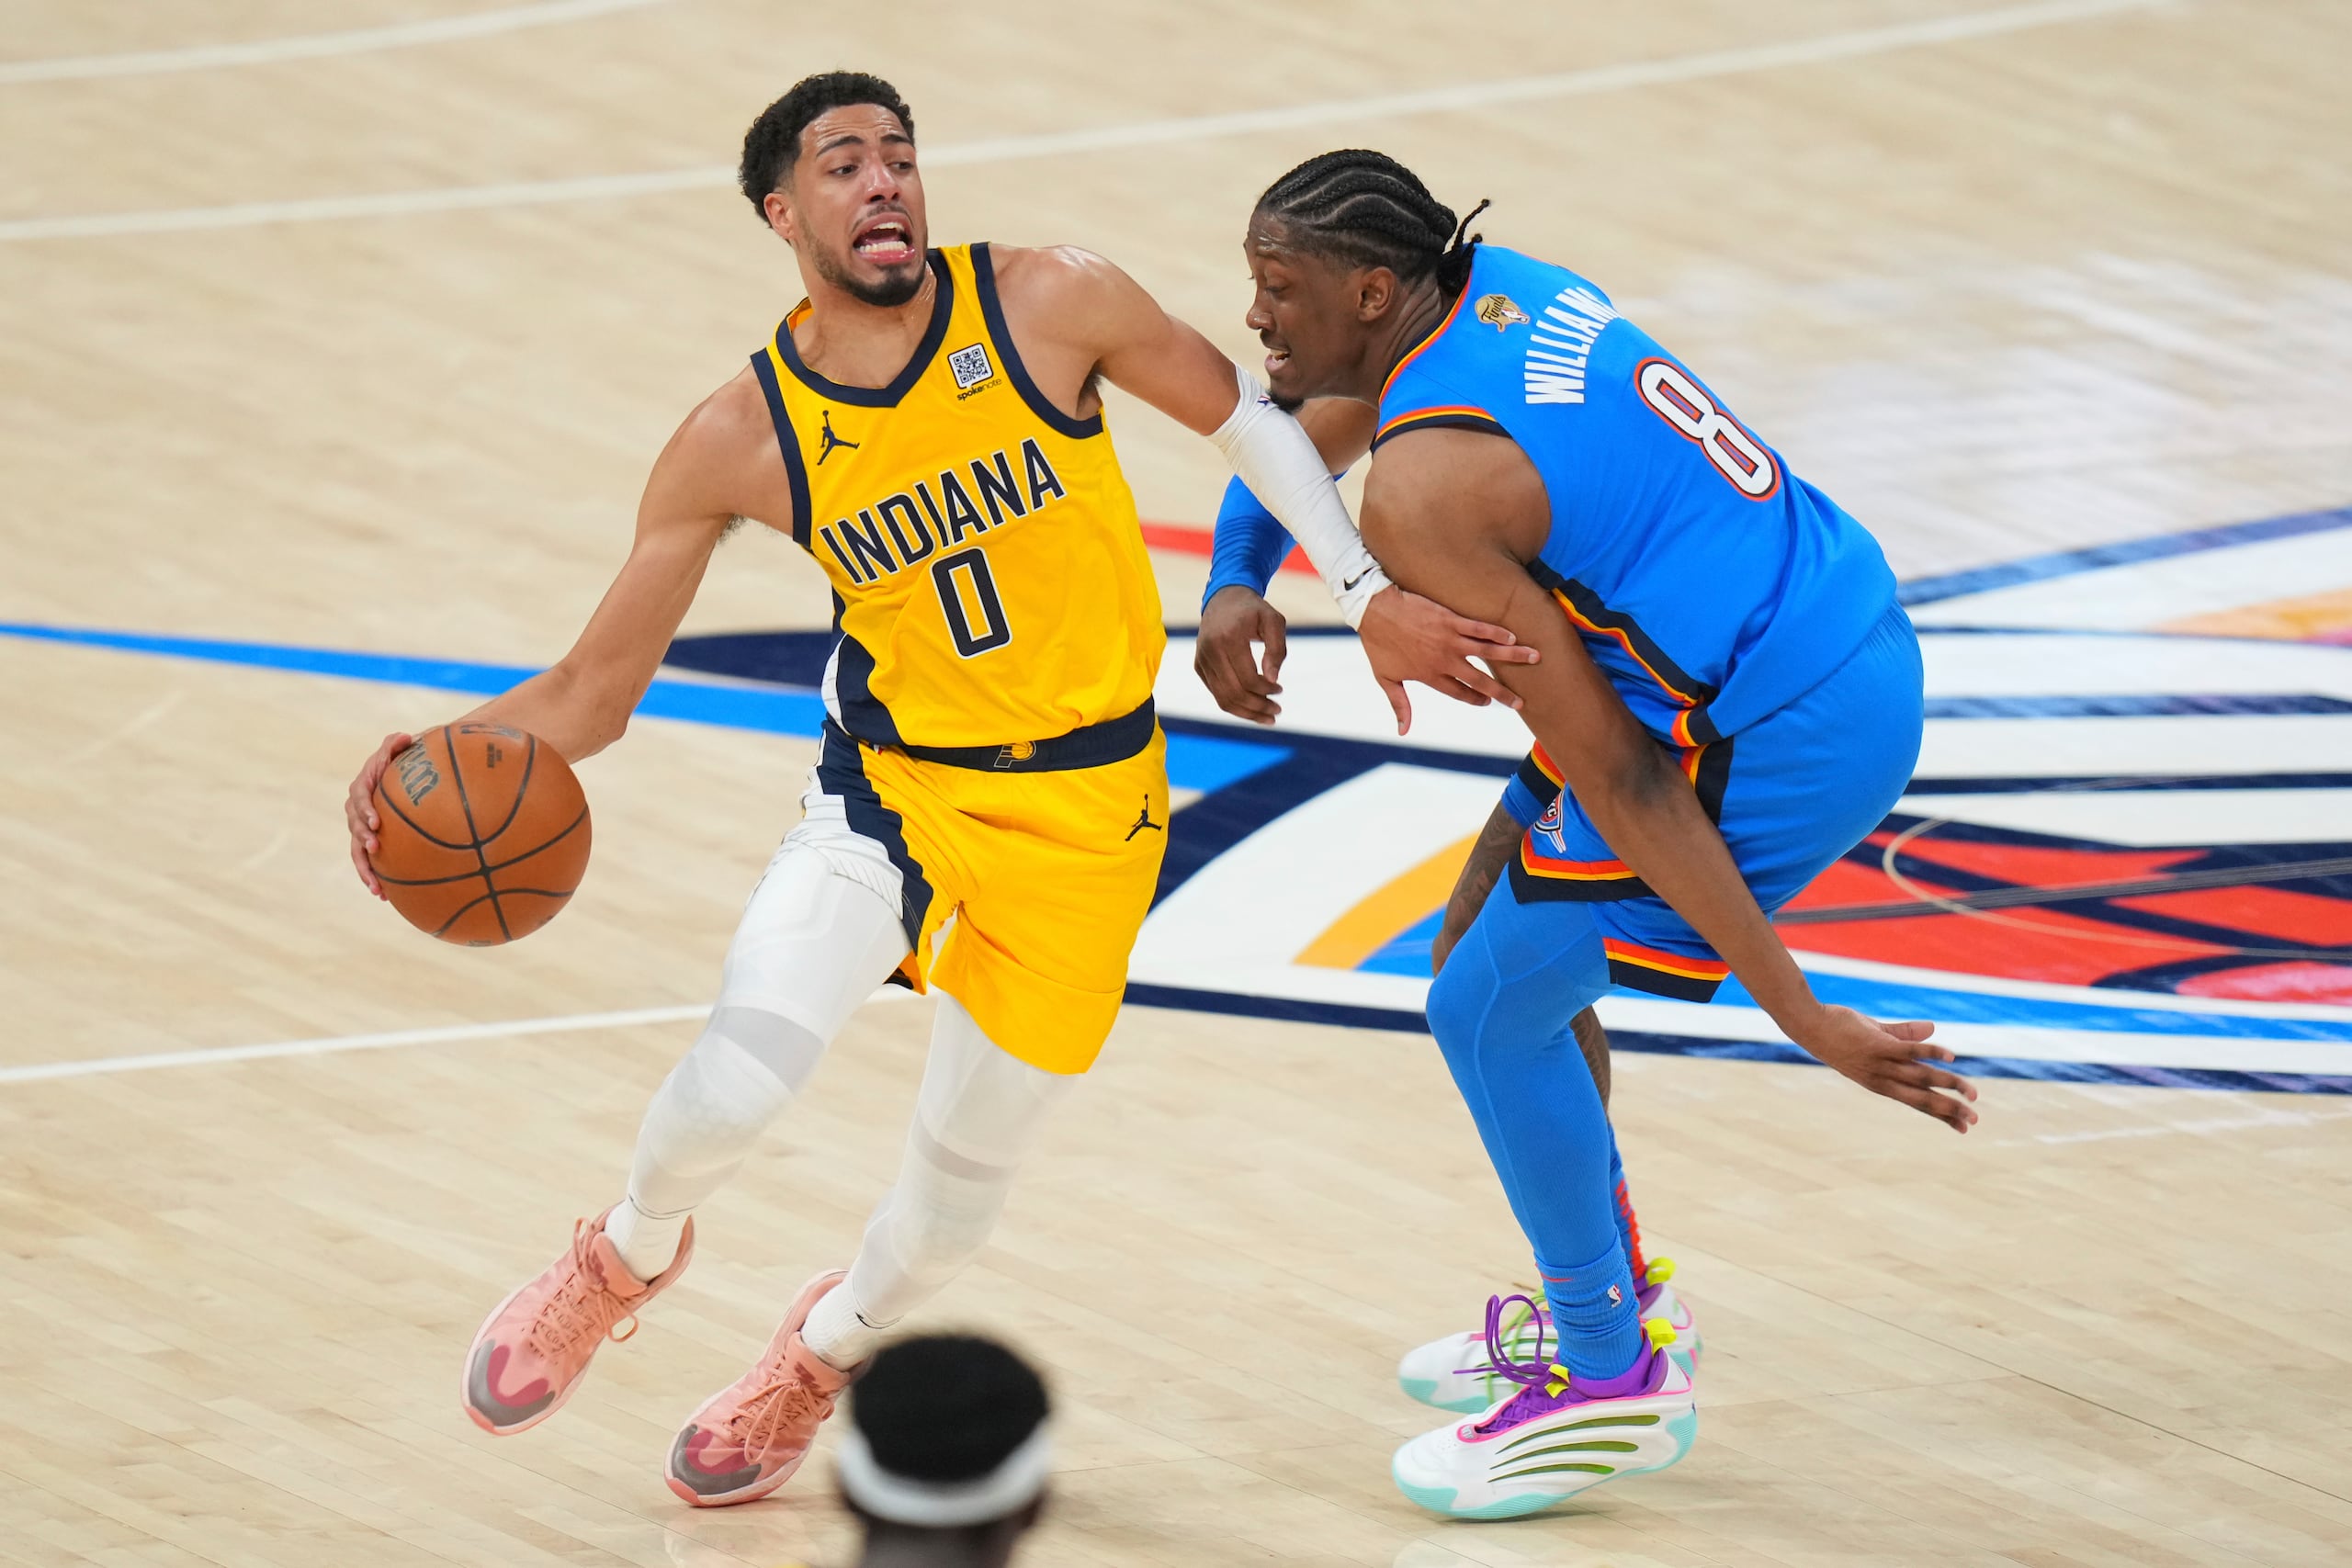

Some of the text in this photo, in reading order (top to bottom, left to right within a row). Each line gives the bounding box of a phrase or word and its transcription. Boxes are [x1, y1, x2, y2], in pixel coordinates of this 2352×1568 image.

[956, 378, 1002, 402] spokenote
[1634, 356, 1781, 502] 8
[819, 436, 1067, 585] INDIANA
[930, 547, 1012, 660] 0
